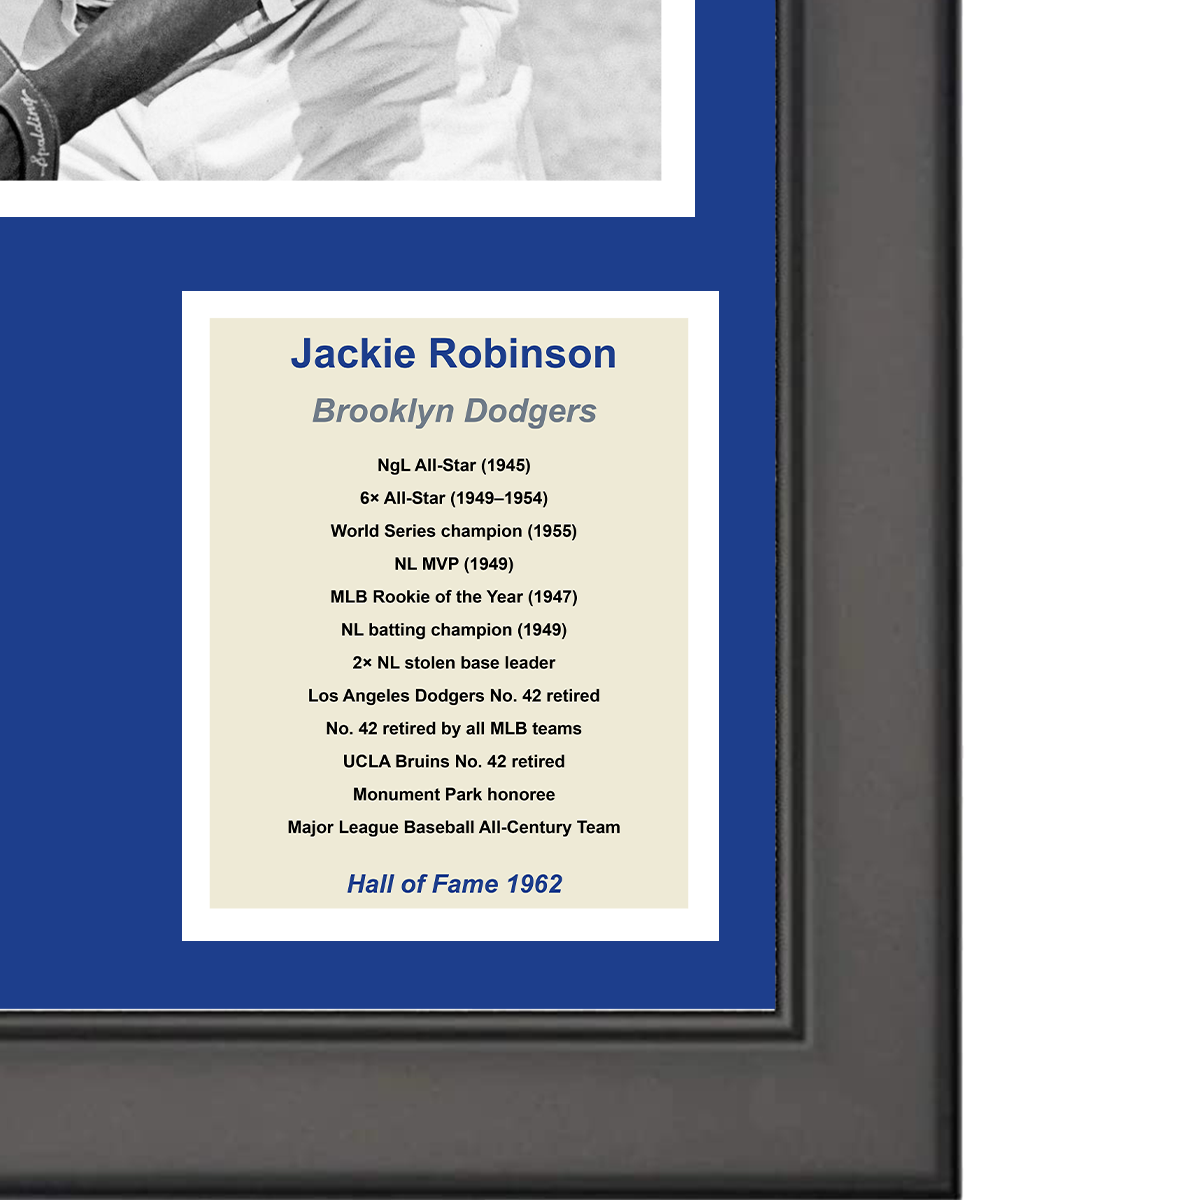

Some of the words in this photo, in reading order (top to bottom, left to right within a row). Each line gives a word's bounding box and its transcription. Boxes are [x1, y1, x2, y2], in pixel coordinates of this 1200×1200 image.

[20, 88, 50, 177] Spalding
[290, 337, 416, 369] Jackie
[430, 337, 616, 369] Robinson
[312, 397, 454, 430] Brooklyn
[464, 397, 597, 430] Dodgers
[377, 457, 412, 476] NgL
[414, 457, 477, 472] All-Star
[481, 457, 531, 476] (1945)
[383, 490, 447, 505] All-Star
[330, 523, 379, 538] World
[384, 523, 436, 538] Series
[440, 523, 523, 542] champion
[527, 523, 577, 542] (1955)
[394, 556, 418, 571] NL
[422, 556, 460, 571] MVP
[463, 556, 514, 574] (1949)
[330, 589, 368, 604] MLB
[373, 589, 431, 604] Rookie
[434, 589, 453, 604] of
[455, 589, 483, 604] the
[486, 589, 524, 604] Year
[528, 589, 578, 607] (1947)
[341, 622, 365, 637] NL
[368, 622, 426, 640] batting
[430, 622, 513, 640] champion
[517, 622, 567, 640] (1949)
[377, 655, 401, 670] NL
[404, 655, 456, 670] stolen
[460, 655, 500, 670] base
[505, 655, 557, 670] leader
[308, 688, 339, 703] Los
[342, 688, 410, 706] Angeles
[415, 688, 485, 706] Dodgers
[490, 688, 518, 703] No.
[521, 688, 542, 703] 42
[546, 688, 600, 703] retired
[326, 721, 354, 736] No.
[358, 721, 378, 736] 42
[382, 721, 436, 736] retired
[441, 721, 462, 739] by
[465, 721, 485, 736] all
[490, 721, 528, 736] MLB
[531, 721, 582, 736] teams
[343, 753, 392, 769] UCLA
[395, 753, 450, 769] Bruins
[455, 753, 482, 769] No.
[486, 753, 507, 769] 42
[511, 753, 565, 769] retired
[353, 787, 441, 802] Monument
[445, 787, 483, 802] Park
[487, 787, 556, 802] honoree
[287, 819, 335, 838] Major
[339, 819, 399, 838] League
[404, 819, 475, 834] Baseball
[478, 819, 573, 838] All-Century
[576, 819, 621, 834] Team
[346, 873, 395, 894] Hall
[400, 873, 428, 894] of
[431, 873, 499, 894] Fame
[507, 873, 563, 894] 1962
